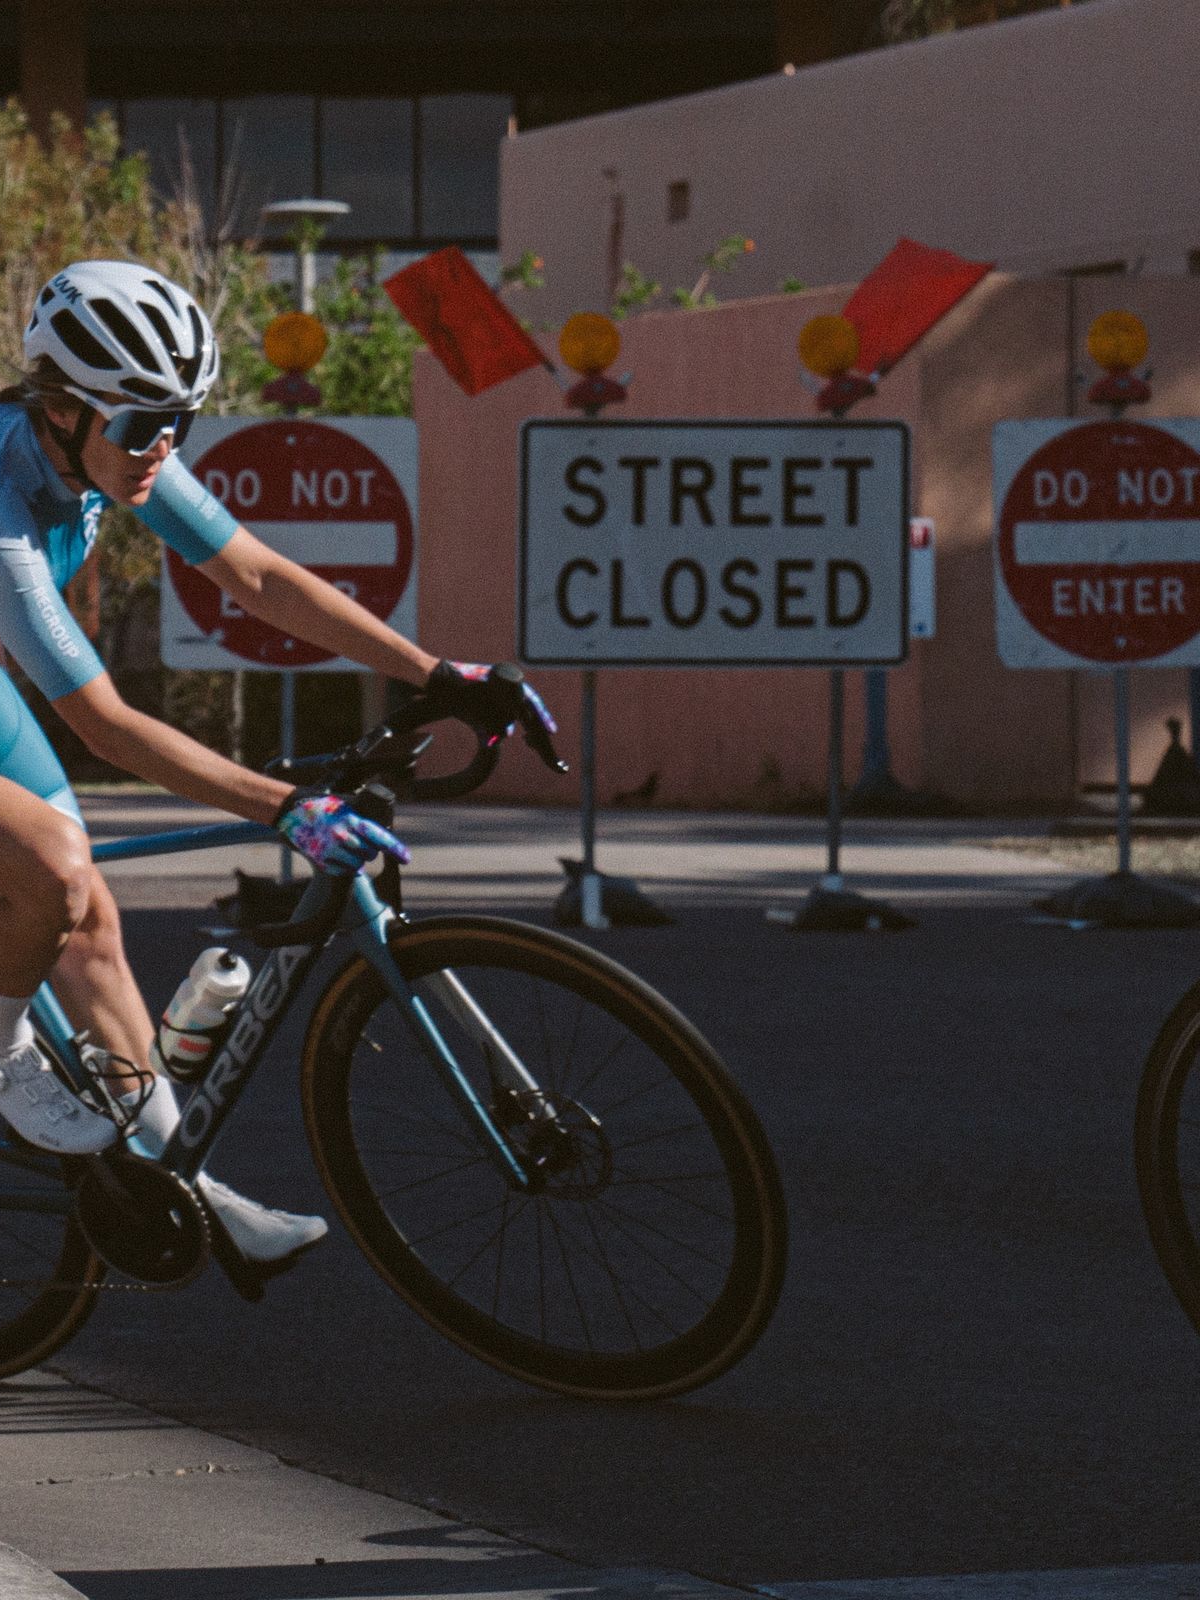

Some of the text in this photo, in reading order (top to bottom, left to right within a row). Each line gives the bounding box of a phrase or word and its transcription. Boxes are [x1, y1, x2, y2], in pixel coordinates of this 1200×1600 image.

[205, 469, 376, 507] DO NOT
[563, 455, 875, 528] STREET
[1033, 466, 1200, 507] DO NOT
[555, 557, 873, 629] CLOSED
[1052, 576, 1186, 617] ENTER
[179, 944, 312, 1148] ORBEA
